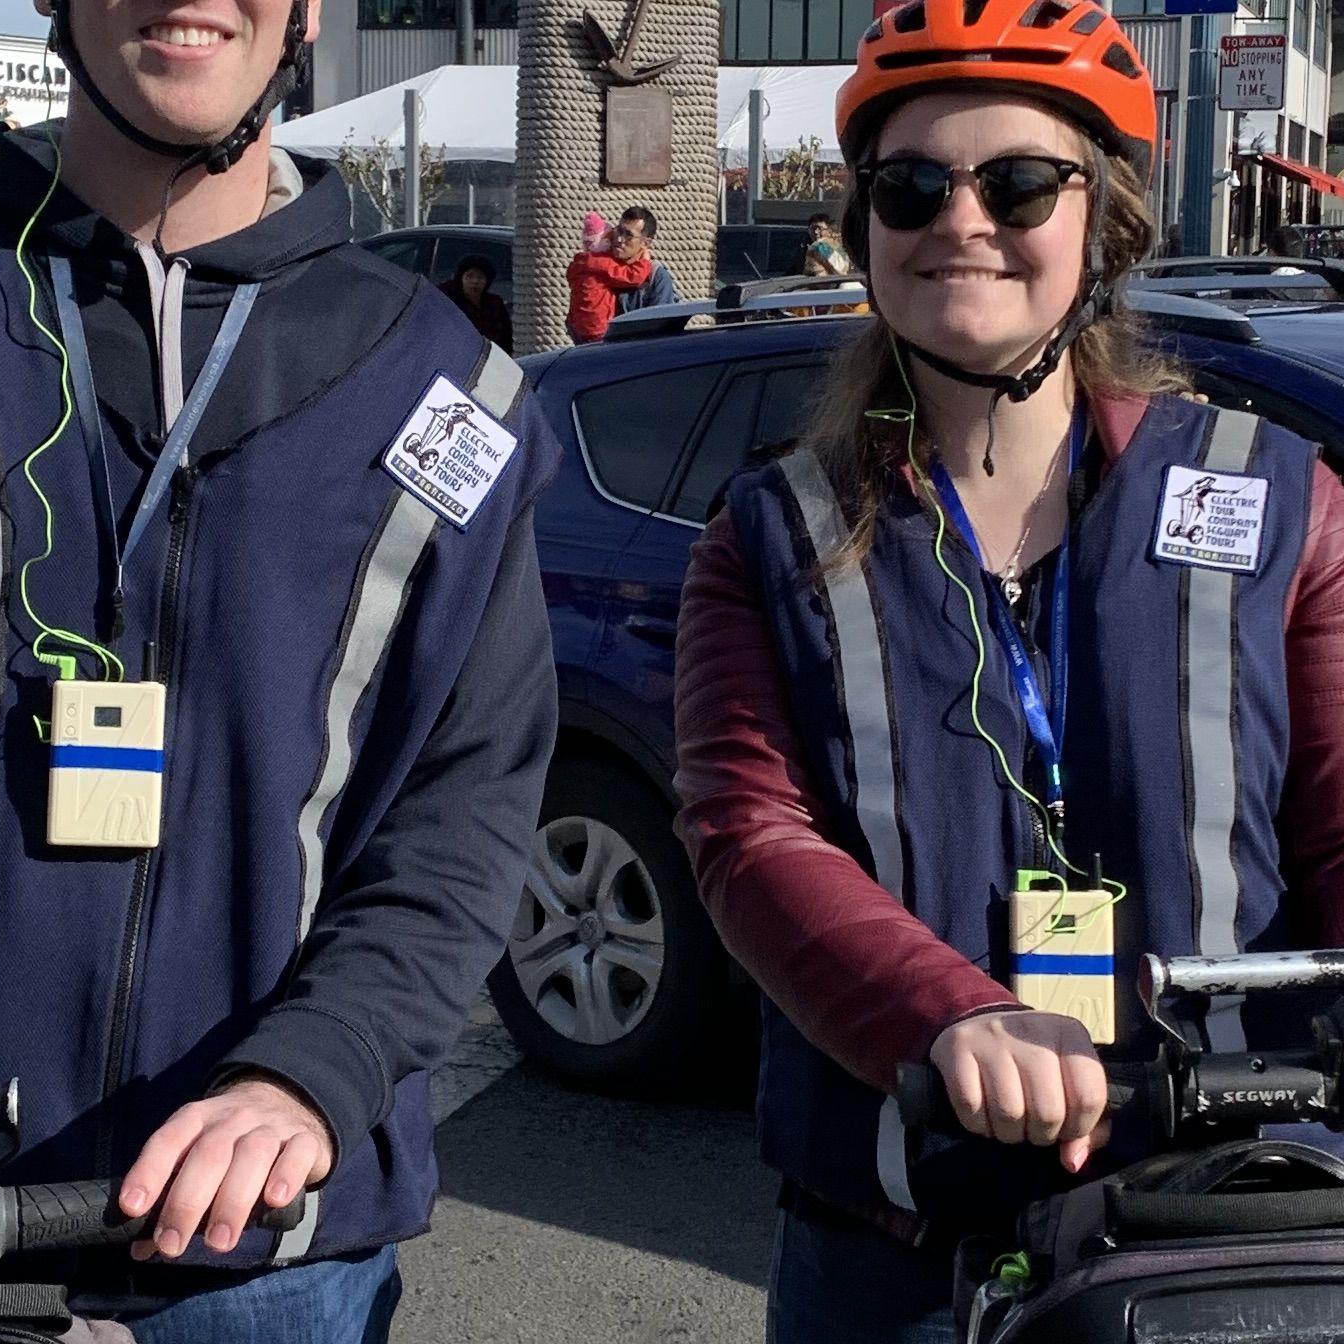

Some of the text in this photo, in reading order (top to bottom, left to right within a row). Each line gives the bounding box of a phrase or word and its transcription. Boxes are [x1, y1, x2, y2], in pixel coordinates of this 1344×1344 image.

[1225, 37, 1282, 47] TOW-AWAY
[1221, 49, 1282, 66] NO STOPPING
[1239, 69, 1265, 81] ANY
[1236, 84, 1267, 97] TIME
[455, 435, 478, 460] TOUR
[460, 426, 503, 463] ELECTRIC
[448, 446, 493, 483] COMPANY
[432, 465, 464, 492] TOURS
[440, 456, 480, 489] SEGWAY
[1211, 495, 1258, 508] ELECTRIC
[1211, 505, 1236, 516] TOUR
[1207, 515, 1259, 528] COMPANY
[1207, 525, 1249, 538] SEGWAY
[1205, 535, 1236, 548] TOURS
[1222, 1089, 1297, 1103] SEGWAY
